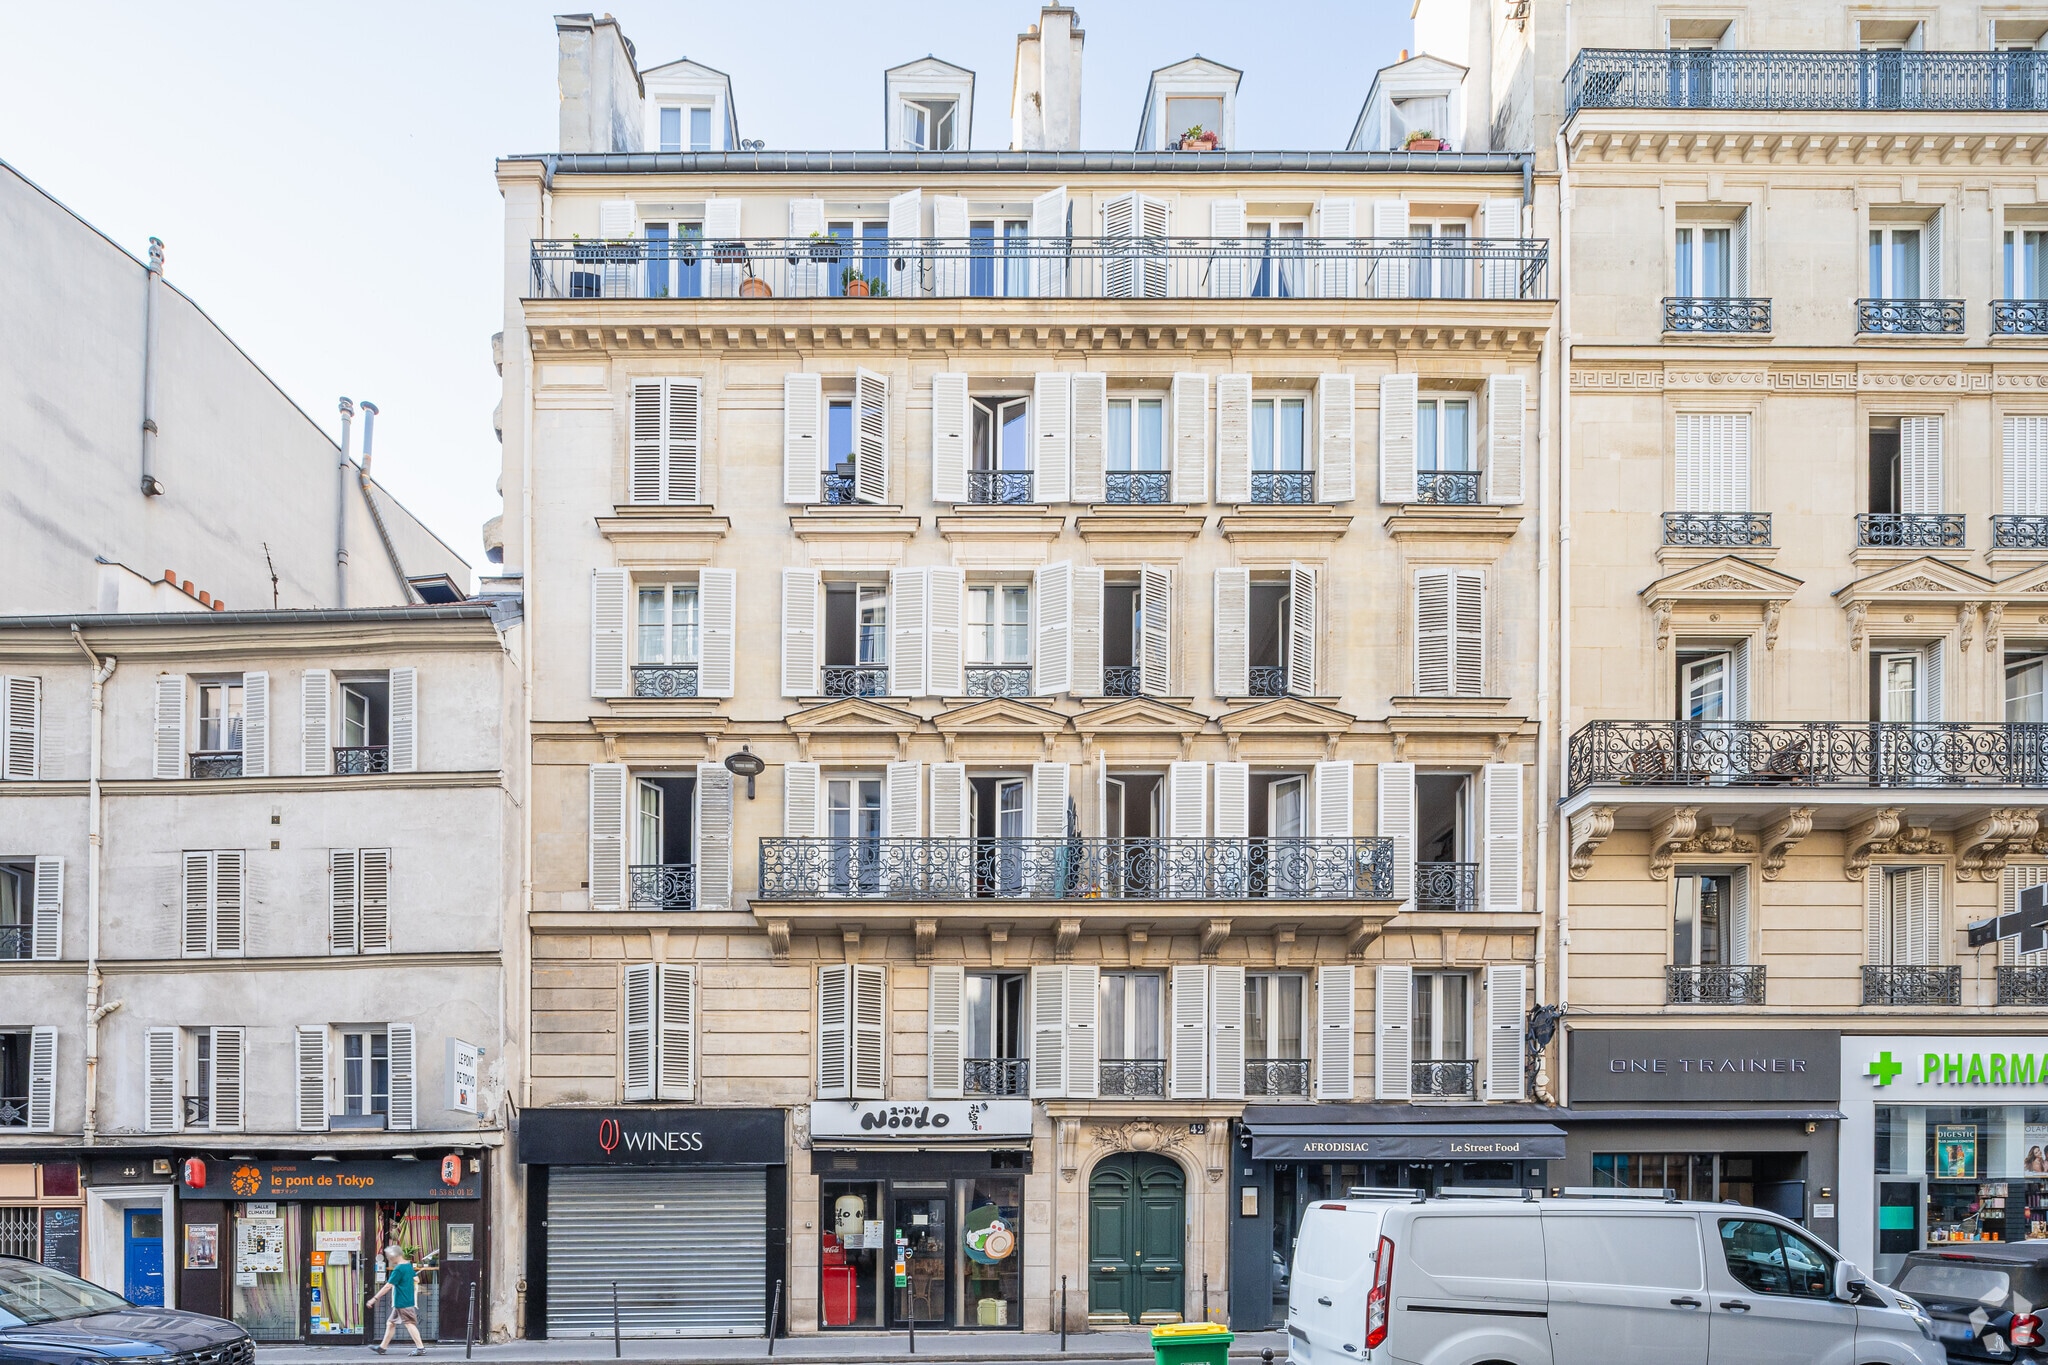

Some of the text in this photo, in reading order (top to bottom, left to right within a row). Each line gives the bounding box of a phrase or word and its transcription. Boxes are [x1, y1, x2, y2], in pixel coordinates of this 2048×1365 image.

[1610, 1059, 1807, 1073] ONE TRAINER
[861, 1106, 950, 1131] Noodo
[1190, 1124, 1204, 1134] 42
[623, 1132, 703, 1151] WINESS
[1304, 1142, 1369, 1152] AFRODISIAC
[1450, 1142, 1520, 1152] Le Street Food
[123, 1167, 136, 1176] 44
[271, 1174, 374, 1188] le pont de Tokyo
[429, 1188, 474, 1196] 01 53 81 01 12
